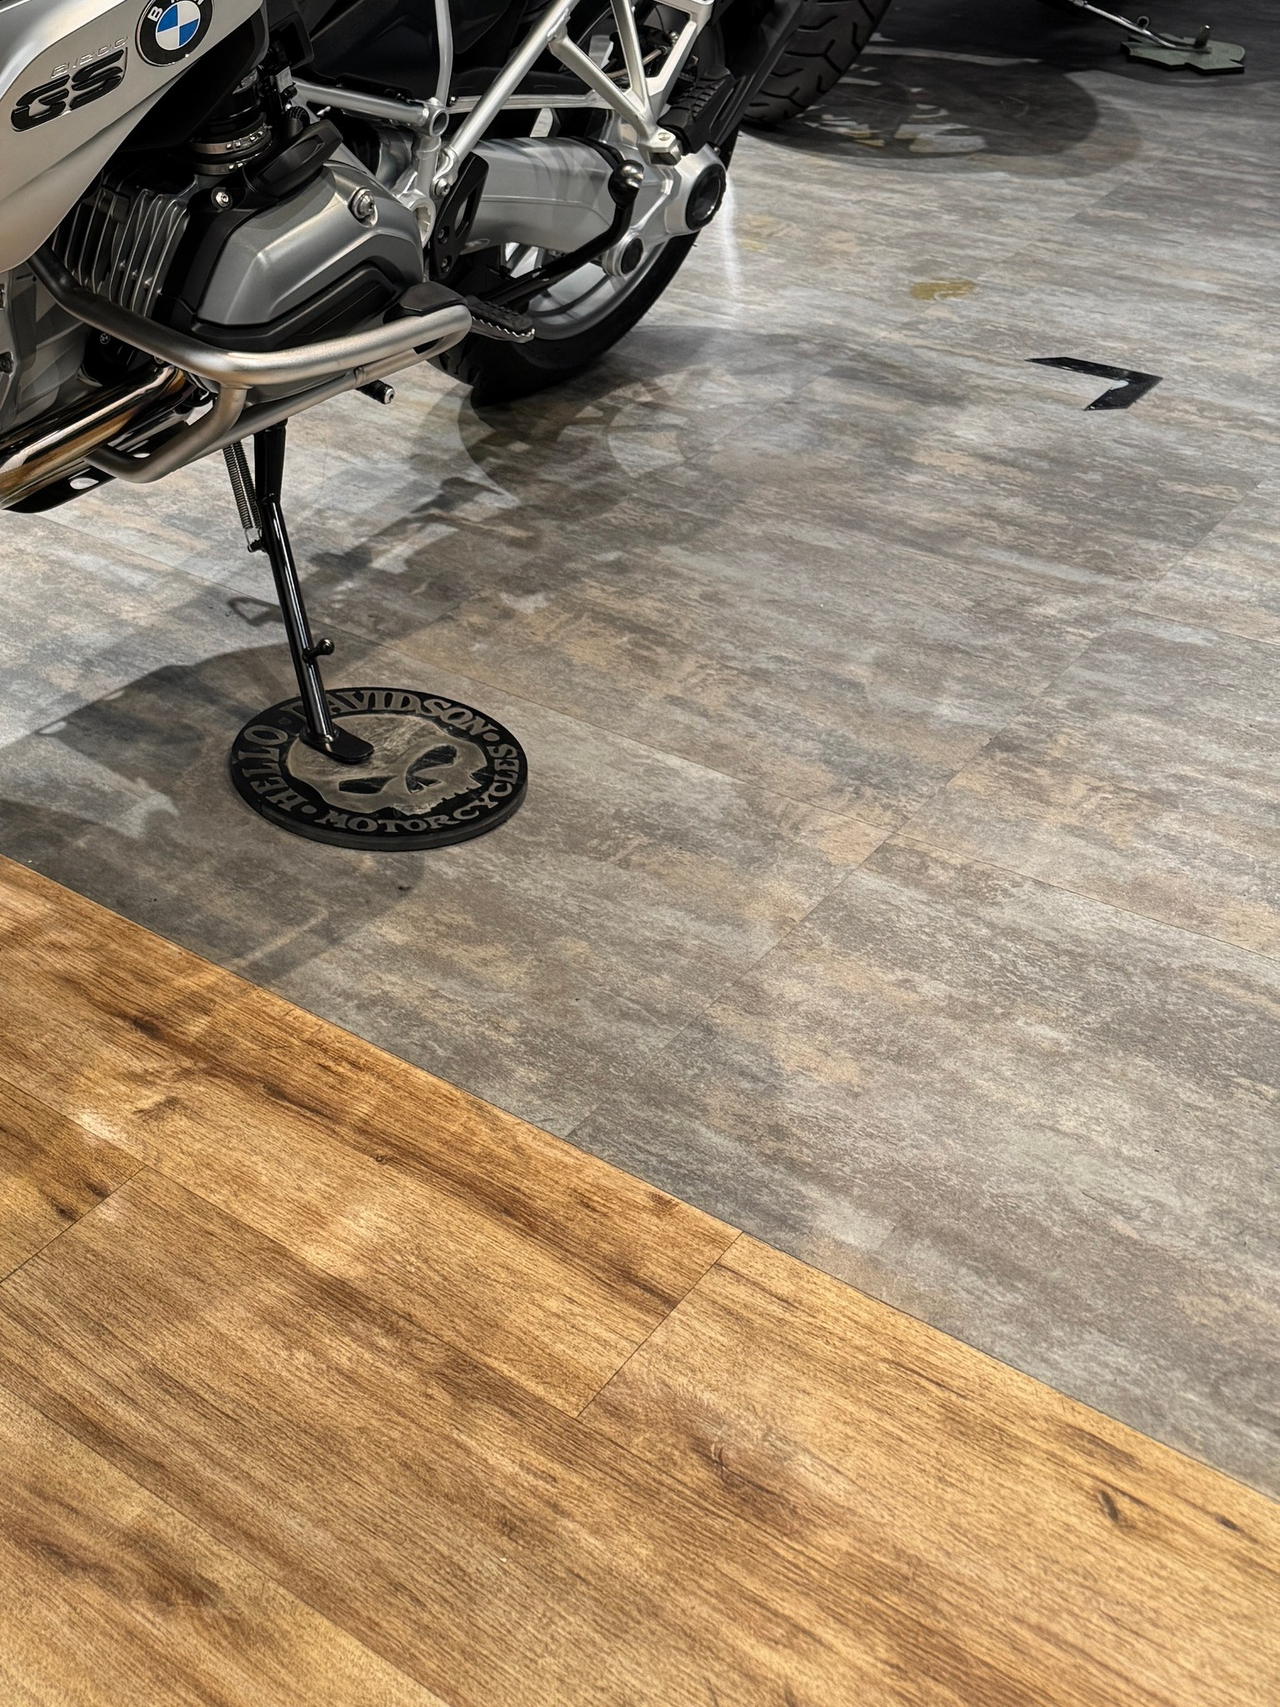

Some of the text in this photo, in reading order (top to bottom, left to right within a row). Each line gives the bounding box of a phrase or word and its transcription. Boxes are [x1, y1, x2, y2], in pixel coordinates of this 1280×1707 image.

[11, 49, 125, 133] GS
[238, 724, 309, 812] HELLO
[314, 743, 520, 834] MOTORCYCLES
